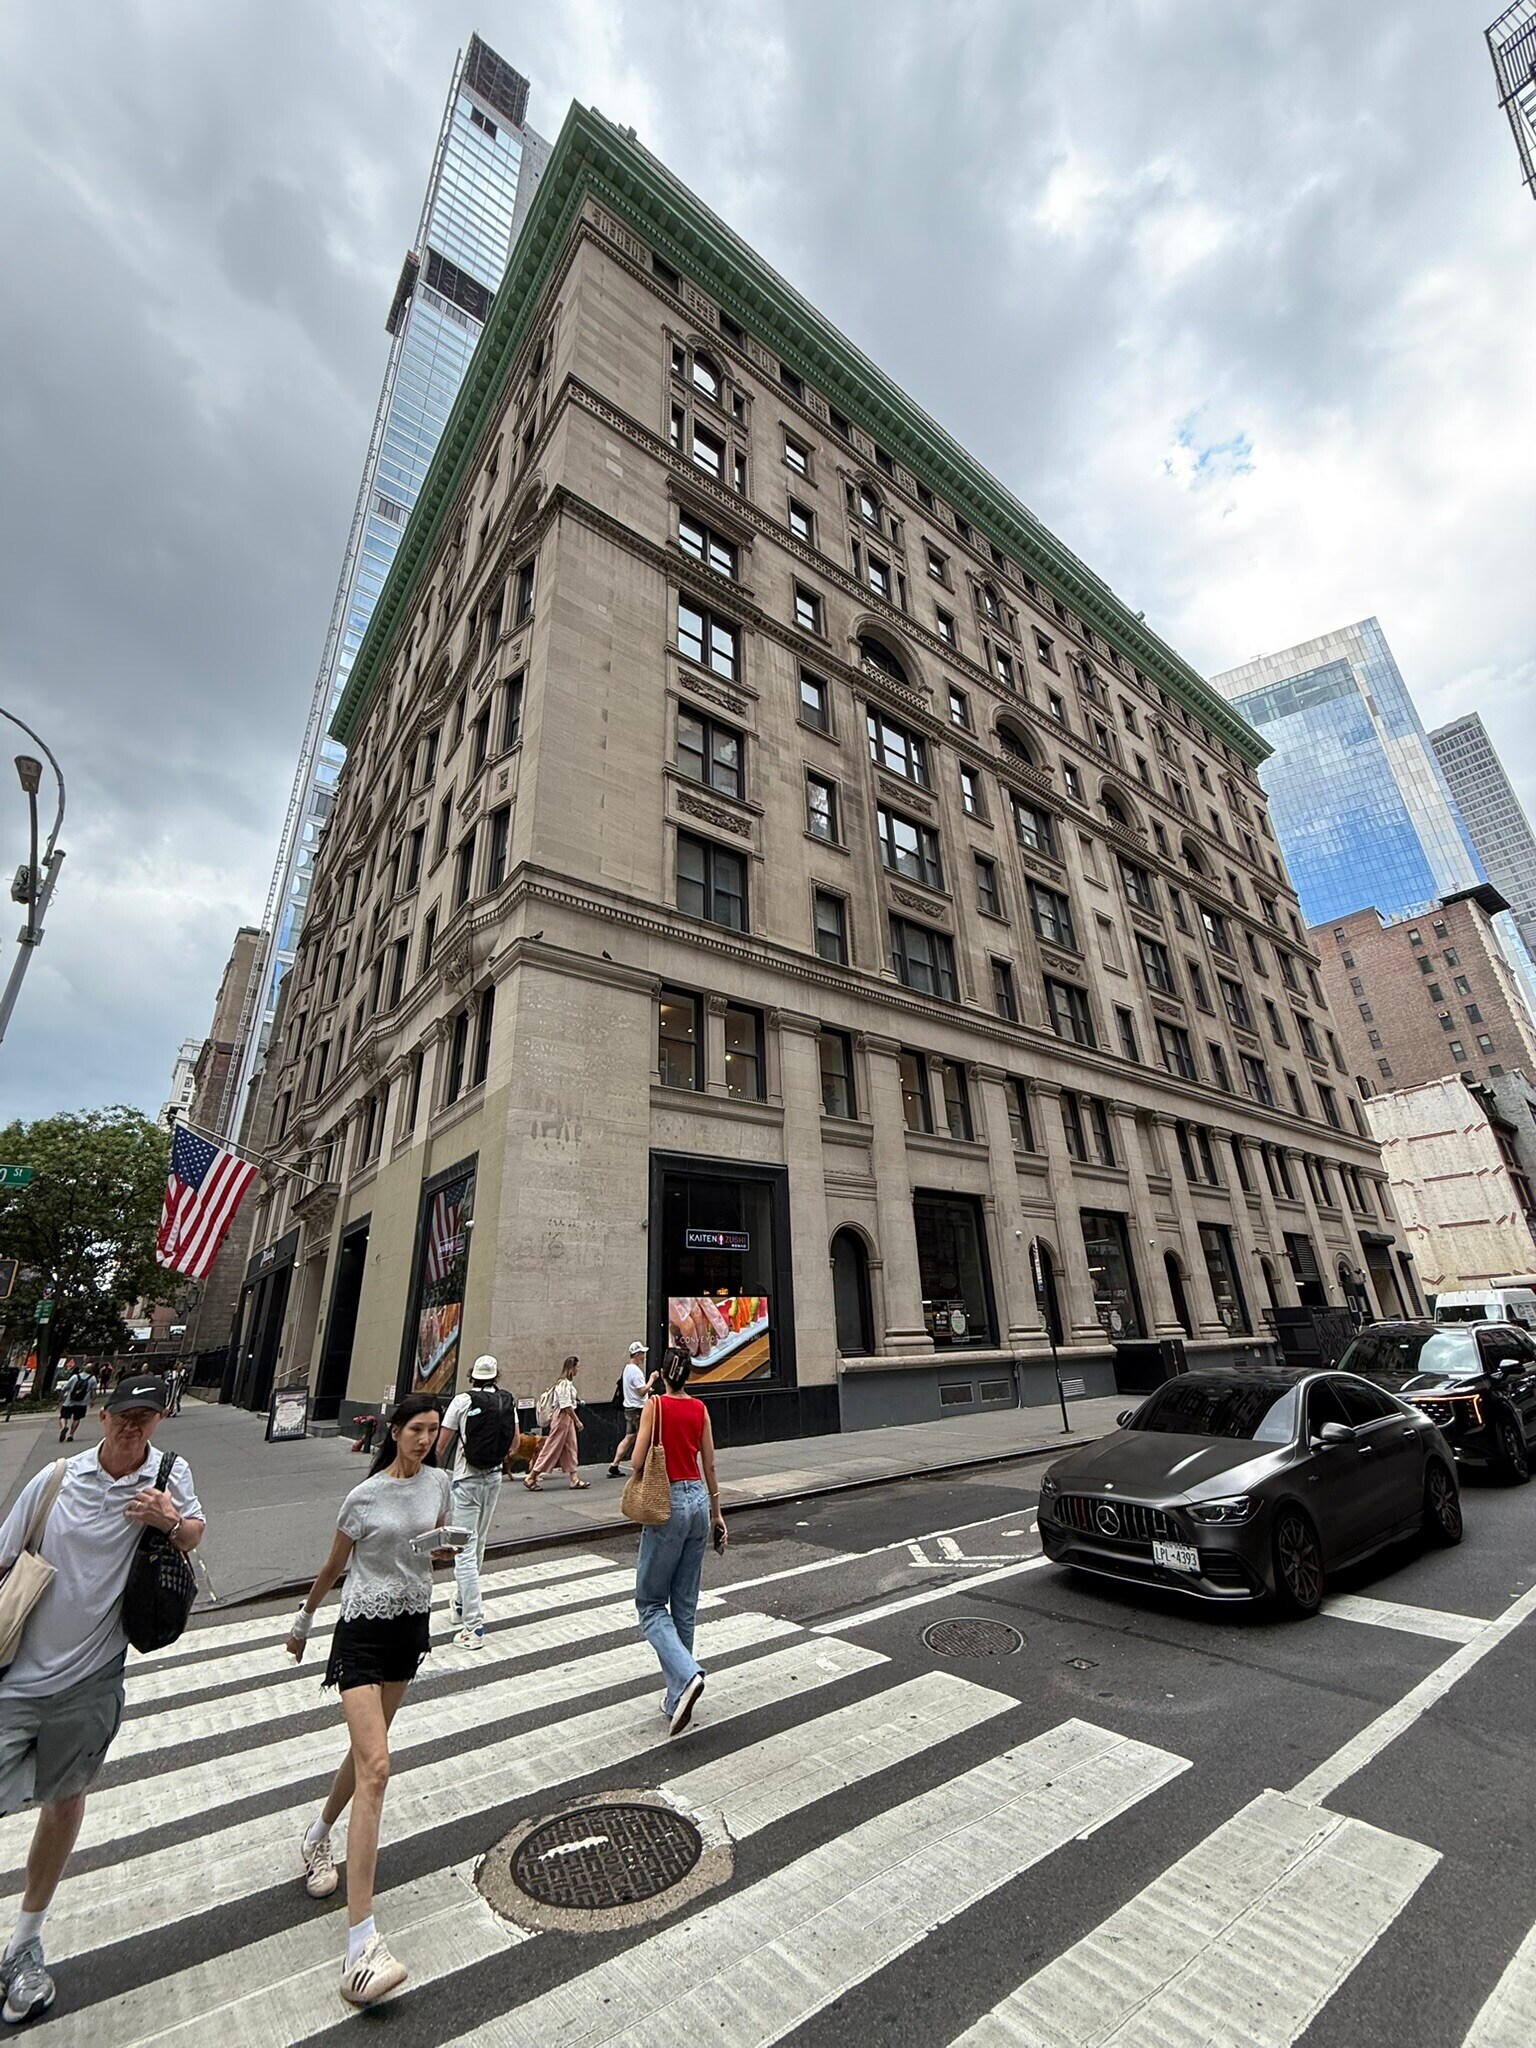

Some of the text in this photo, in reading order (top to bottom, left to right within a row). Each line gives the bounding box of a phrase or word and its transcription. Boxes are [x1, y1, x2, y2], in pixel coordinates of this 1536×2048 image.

[13, 1167, 23, 1177] St
[689, 1234, 746, 1244] KAITEN ZUSHI
